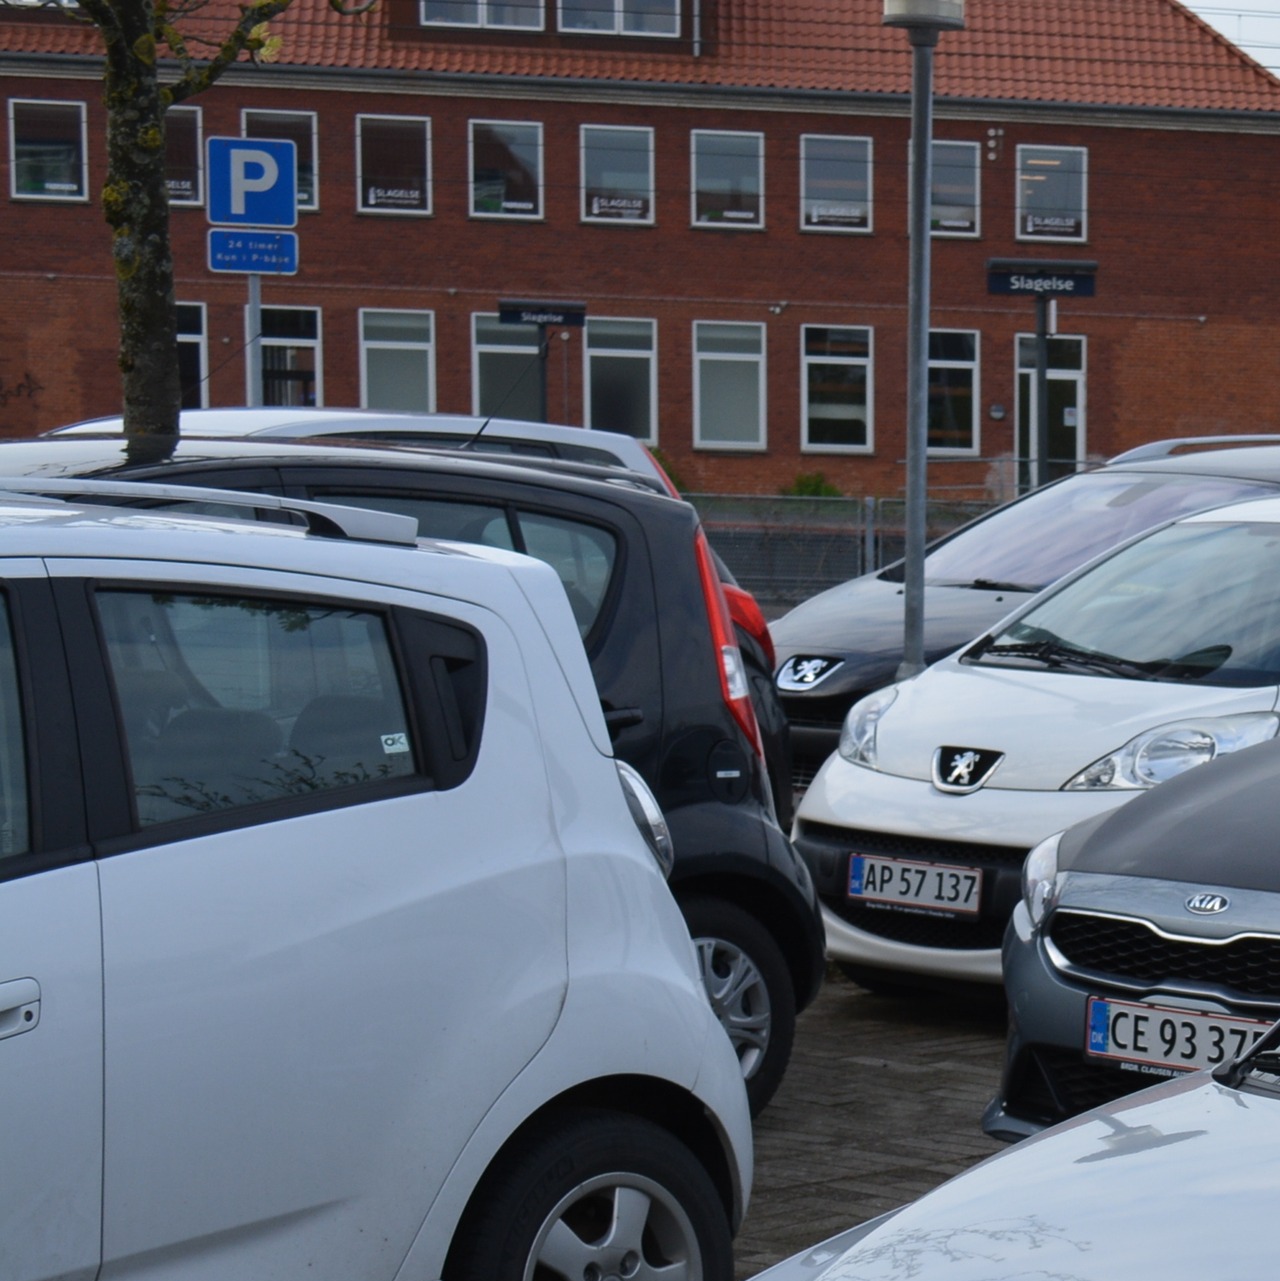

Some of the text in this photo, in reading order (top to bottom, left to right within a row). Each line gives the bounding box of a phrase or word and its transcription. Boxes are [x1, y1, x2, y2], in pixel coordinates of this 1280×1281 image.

[230, 148, 279, 215] P
[228, 240, 279, 250] 24 timer
[216, 253, 237, 261] Kun
[1009, 275, 1075, 292] Slagelse
[521, 311, 564, 323] Slagelse
[383, 734, 405, 747] OK
[864, 863, 977, 904] AP 57 137
[1189, 895, 1222, 910] KIA
[1091, 1032, 1103, 1044] DK
[1111, 1011, 1150, 1053] CE
[1159, 1018, 1197, 1060] 93
[1141, 1065, 1172, 1077] CLAUSEN
